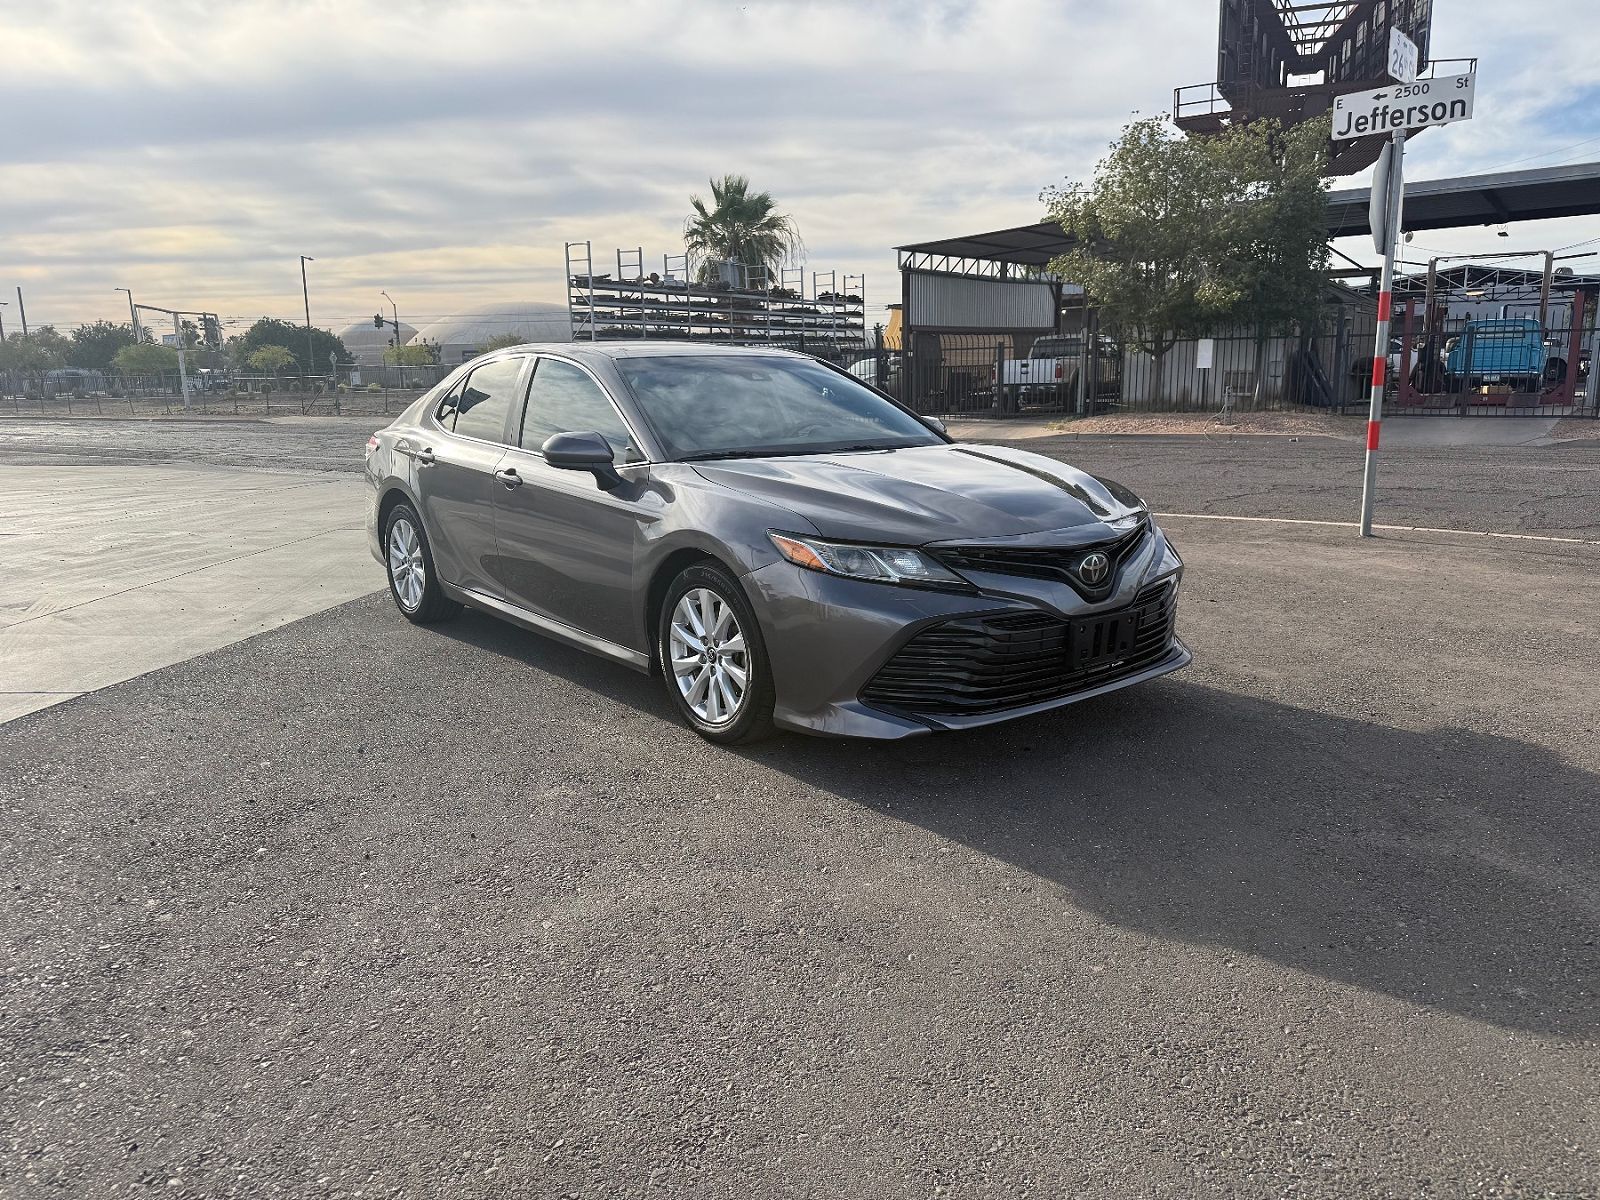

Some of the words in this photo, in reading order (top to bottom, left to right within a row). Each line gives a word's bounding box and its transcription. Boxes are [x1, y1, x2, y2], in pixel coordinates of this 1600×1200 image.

[1336, 98, 1344, 110] E
[1394, 83, 1430, 99] 2500
[1456, 77, 1469, 89] St
[1336, 99, 1466, 136] Jefferson
